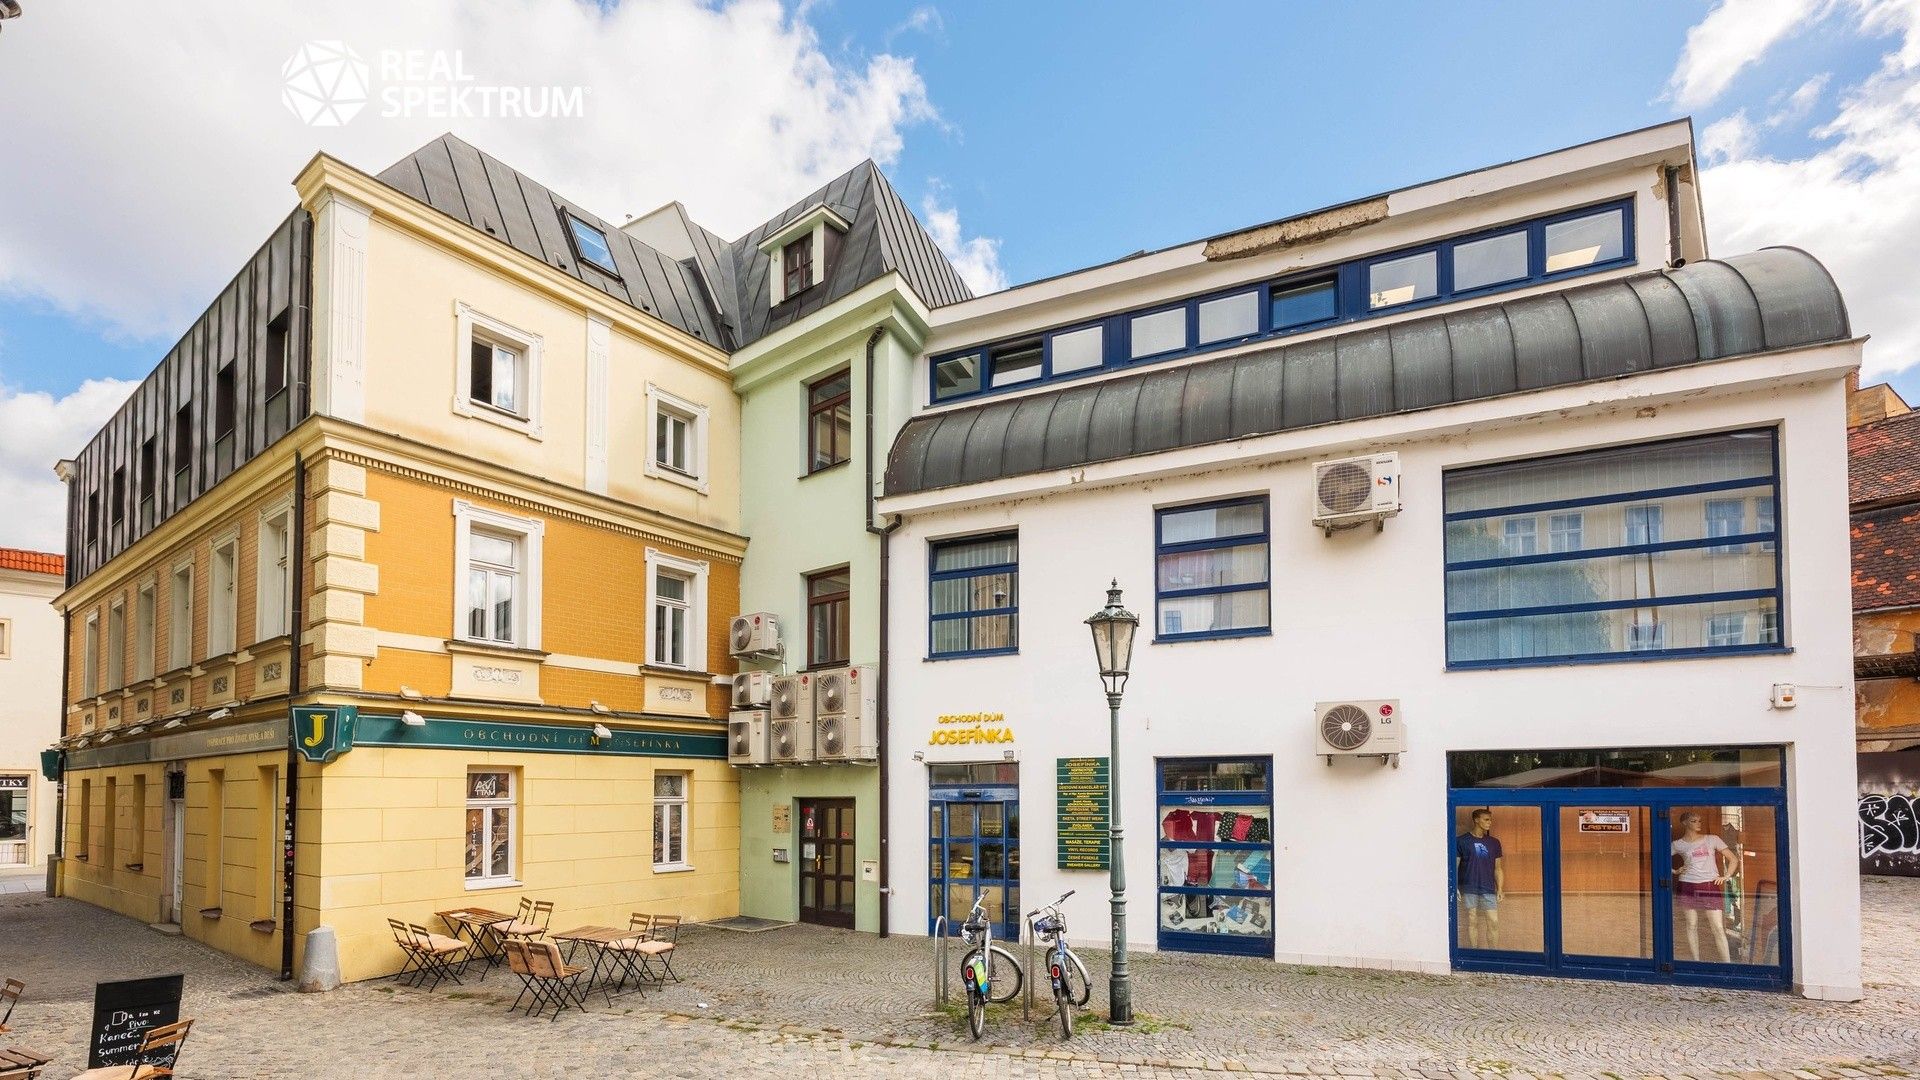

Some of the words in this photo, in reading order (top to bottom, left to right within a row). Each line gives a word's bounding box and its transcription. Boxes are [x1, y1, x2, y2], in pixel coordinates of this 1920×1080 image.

[938, 712, 982, 724] OBCHODNÍ
[304, 715, 328, 746] J
[464, 728, 558, 743] OBCHODNÍ
[929, 725, 1015, 745] JOSEFÍNKA
